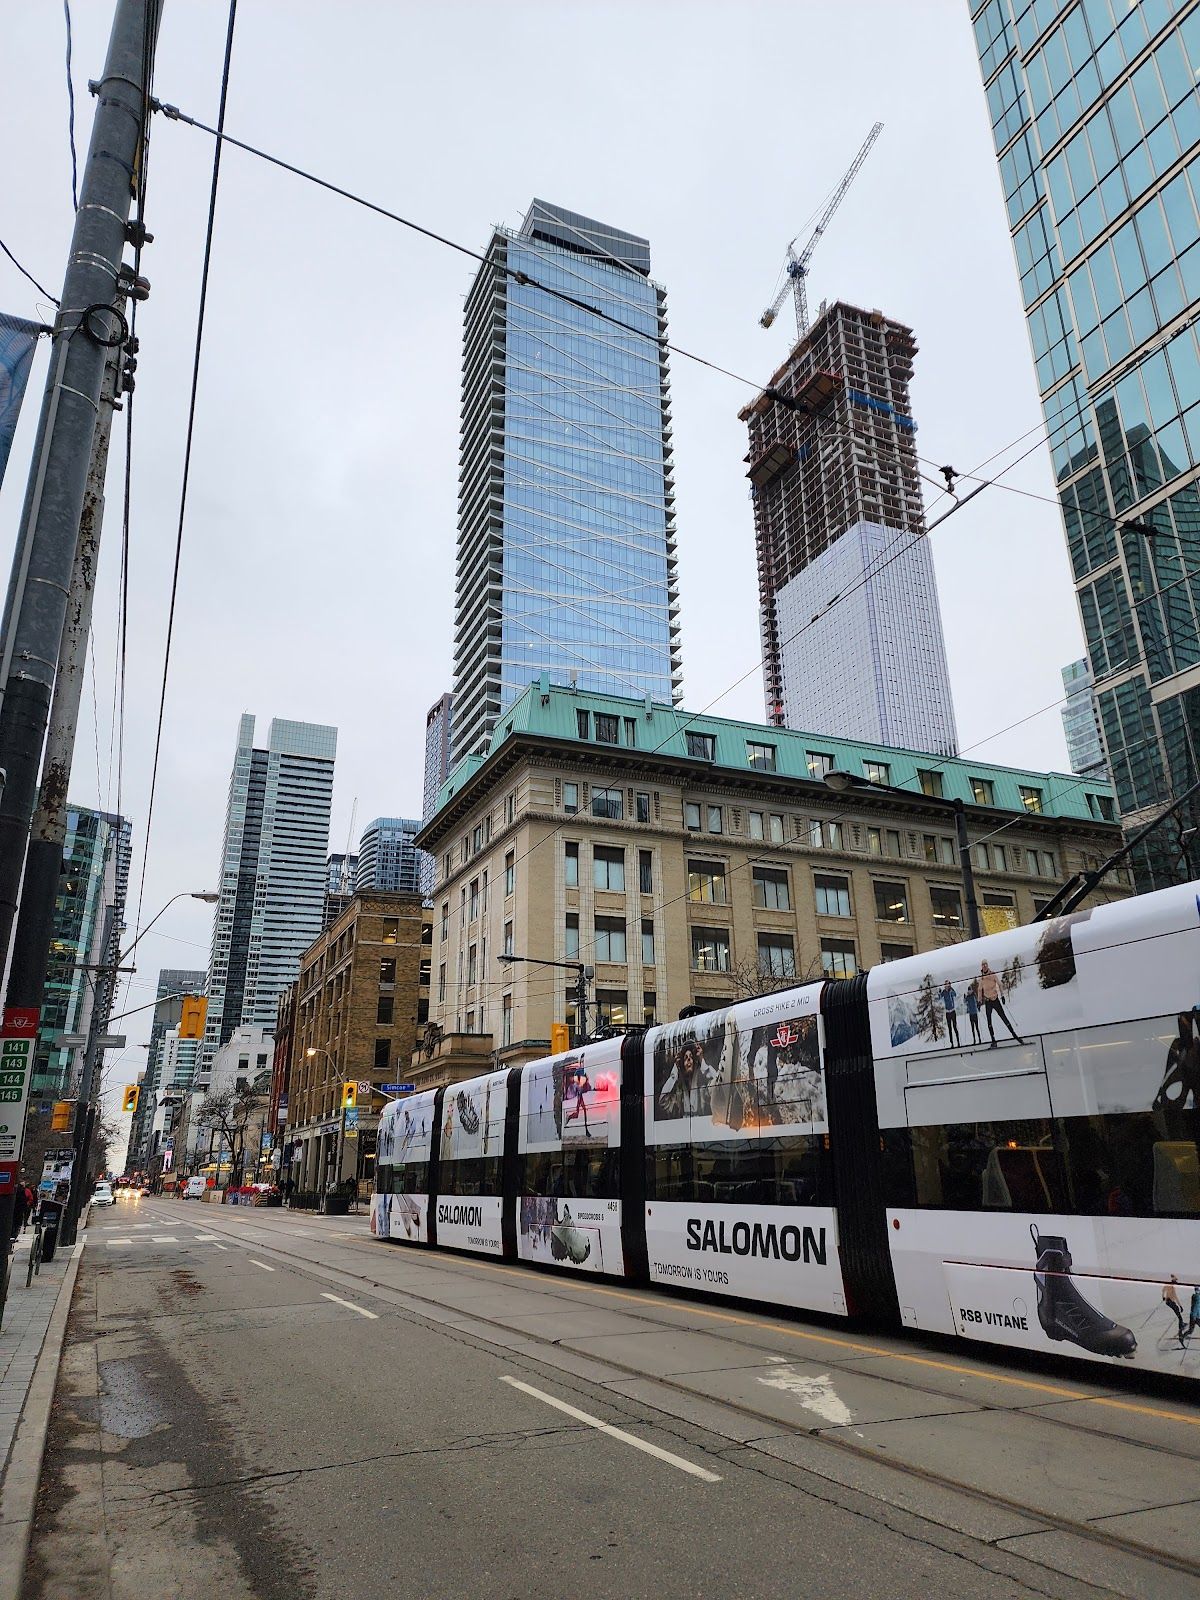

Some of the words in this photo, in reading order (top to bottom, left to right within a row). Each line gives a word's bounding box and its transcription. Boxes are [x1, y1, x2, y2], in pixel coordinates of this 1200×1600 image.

[753, 1005, 775, 1017] CROSS
[776, 1002, 790, 1012] HIKE
[791, 999, 796, 1008] 2
[797, 995, 810, 1006] MID
[9, 1042, 24, 1052] 141
[5, 1059, 23, 1068] 143
[2, 1074, 20, 1084] 144
[0, 1090, 18, 1100] 145
[438, 1204, 482, 1227] SALOMON
[467, 1236, 484, 1246] TOMORROW
[488, 1239, 500, 1249] YOURS
[687, 1218, 827, 1266] SALOMON
[653, 1262, 693, 1279] TOMORROW
[694, 1268, 701, 1281] IS
[702, 1269, 729, 1285] YOURS
[984, 1311, 1029, 1331] VITANE
